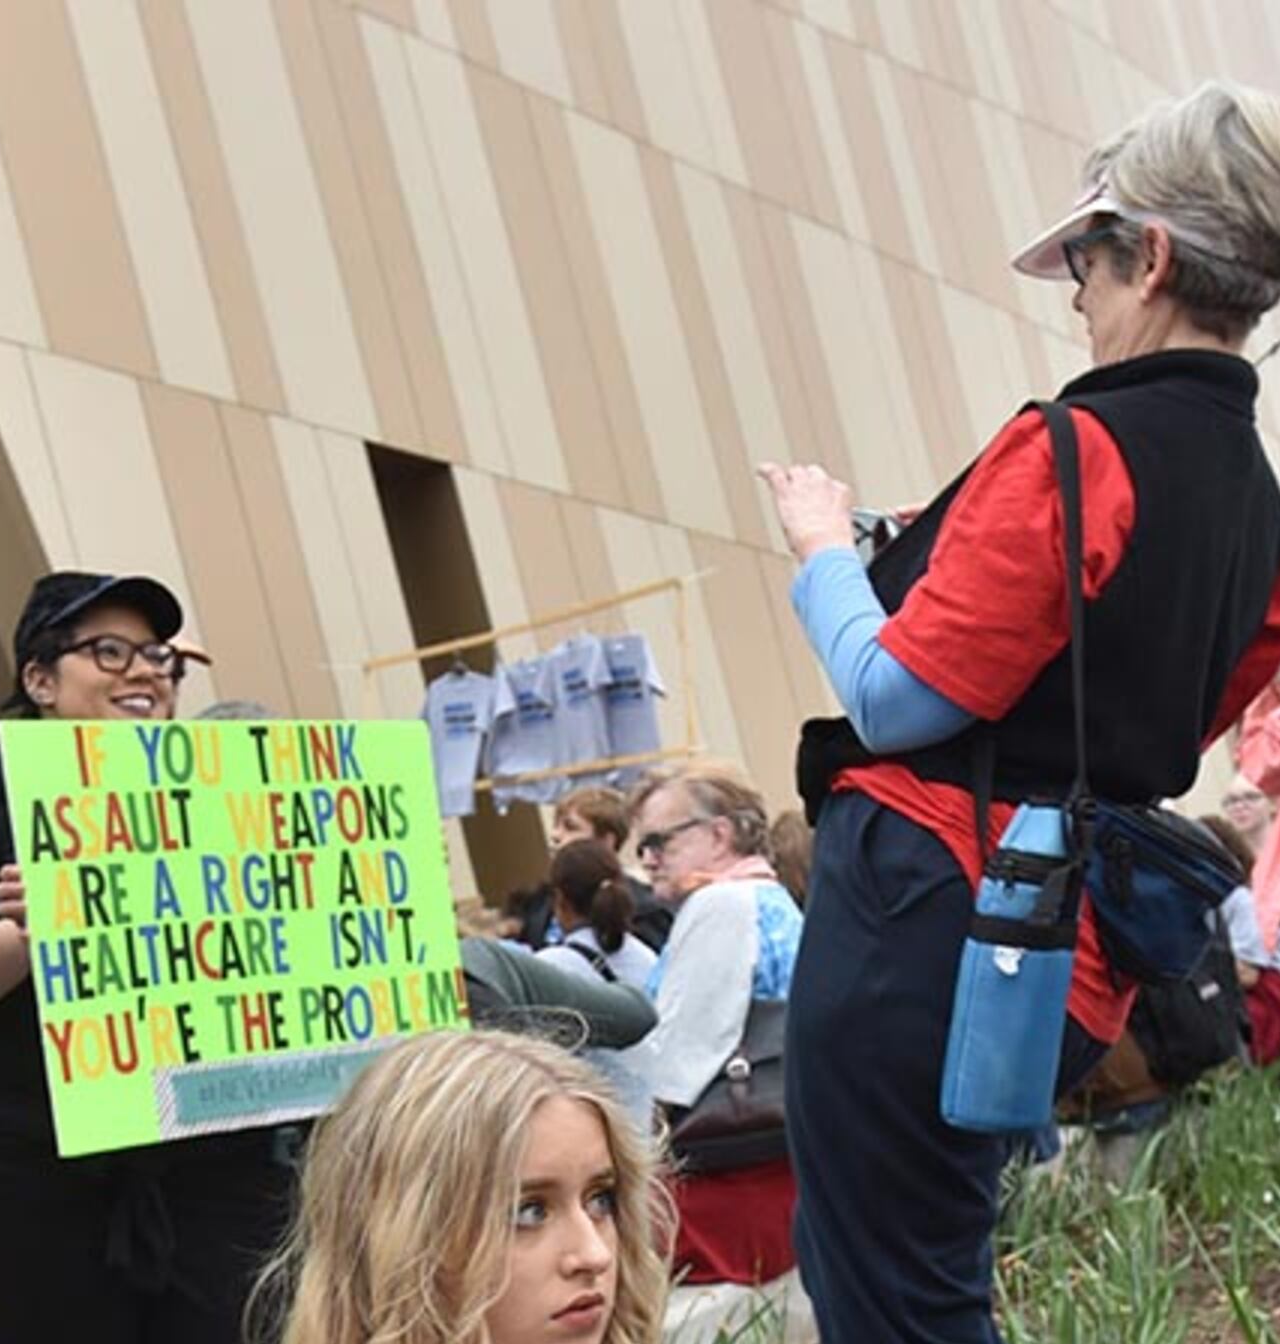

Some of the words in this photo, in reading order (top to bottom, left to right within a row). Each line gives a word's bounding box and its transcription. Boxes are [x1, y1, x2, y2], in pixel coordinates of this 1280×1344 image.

[76, 725, 106, 787] IF
[136, 725, 220, 786] YOU
[249, 725, 362, 784] THINK
[31, 789, 192, 863] ASSAULT
[227, 785, 409, 850] WEAPONS
[54, 863, 130, 930] ARE
[153, 859, 181, 919] A
[203, 852, 315, 914] RIGHT
[338, 850, 408, 906] AND
[39, 917, 291, 1003] HEALTHCARE
[331, 908, 427, 970] ISN'T,
[45, 997, 201, 1084] YOU'RE
[216, 990, 289, 1054] THE
